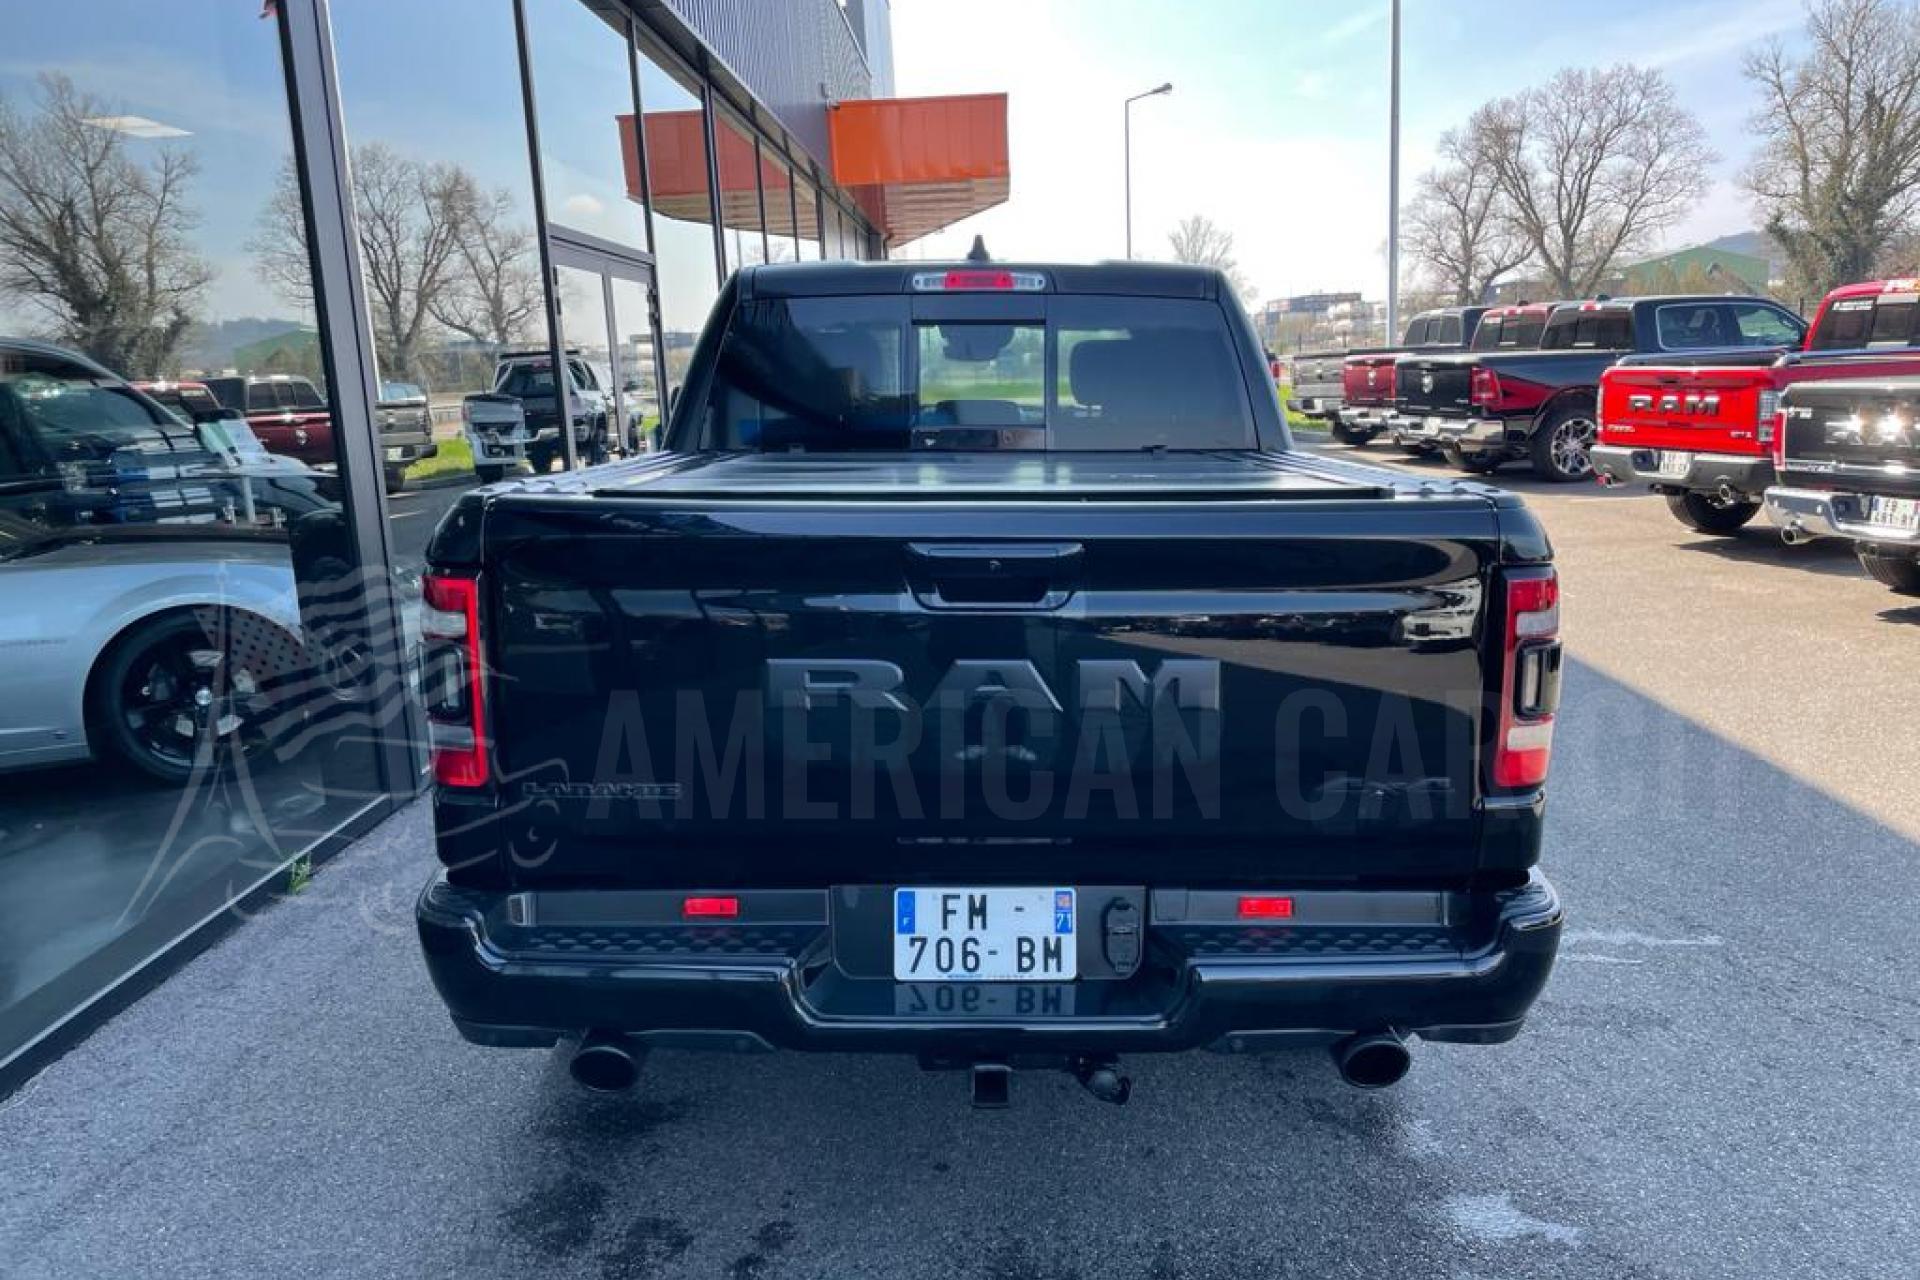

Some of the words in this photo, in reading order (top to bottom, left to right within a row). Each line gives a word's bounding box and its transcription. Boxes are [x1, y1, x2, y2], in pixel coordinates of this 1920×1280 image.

[1628, 394, 1720, 415] RAM
[766, 657, 1222, 713] RAM
[902, 916, 911, 927] F
[941, 893, 988, 931] FM
[1055, 912, 1072, 930] 71
[908, 936, 998, 973] 706-
[1016, 936, 1063, 973] BM
